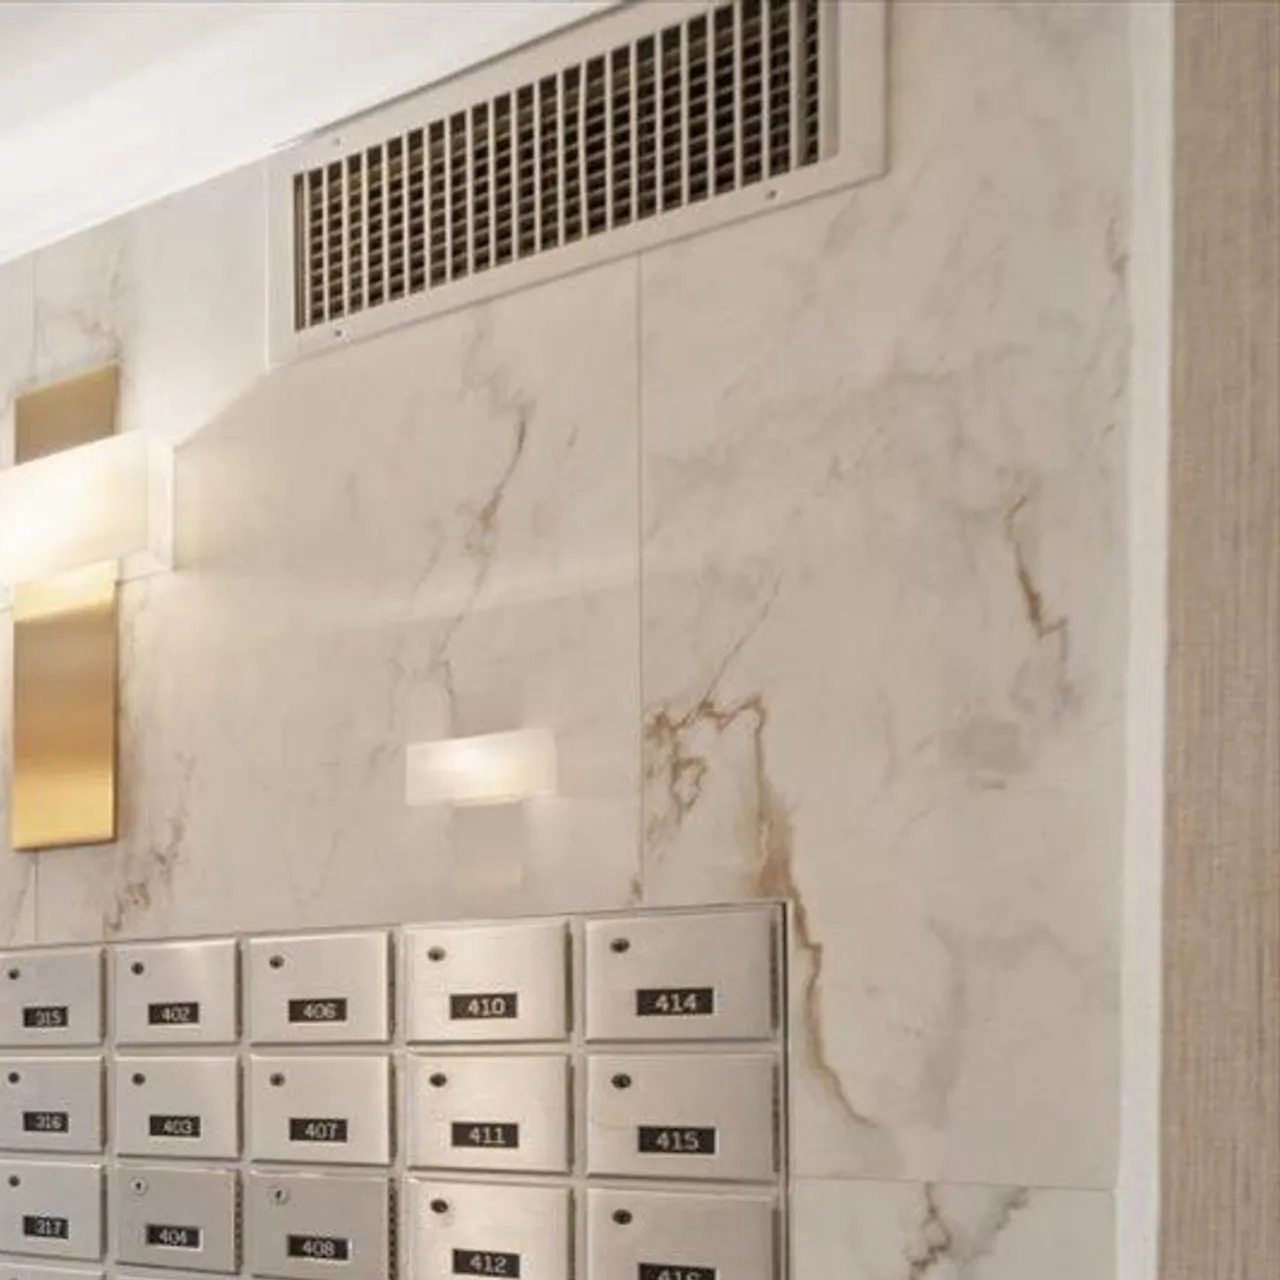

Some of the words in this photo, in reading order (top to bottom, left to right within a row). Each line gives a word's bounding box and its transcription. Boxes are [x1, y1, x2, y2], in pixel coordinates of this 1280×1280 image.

[303, 1003, 337, 1019] 406
[467, 998, 506, 1017] 410
[655, 993, 698, 1013] 414
[161, 1007, 190, 1021] 402
[163, 1118, 193, 1135] 403
[305, 1123, 338, 1139] 407
[469, 1128, 506, 1144] 411
[656, 1131, 700, 1151] 415
[36, 1219, 63, 1235] 317
[159, 1229, 188, 1245] 404
[303, 1241, 336, 1258] 408
[469, 1255, 507, 1274] 412
